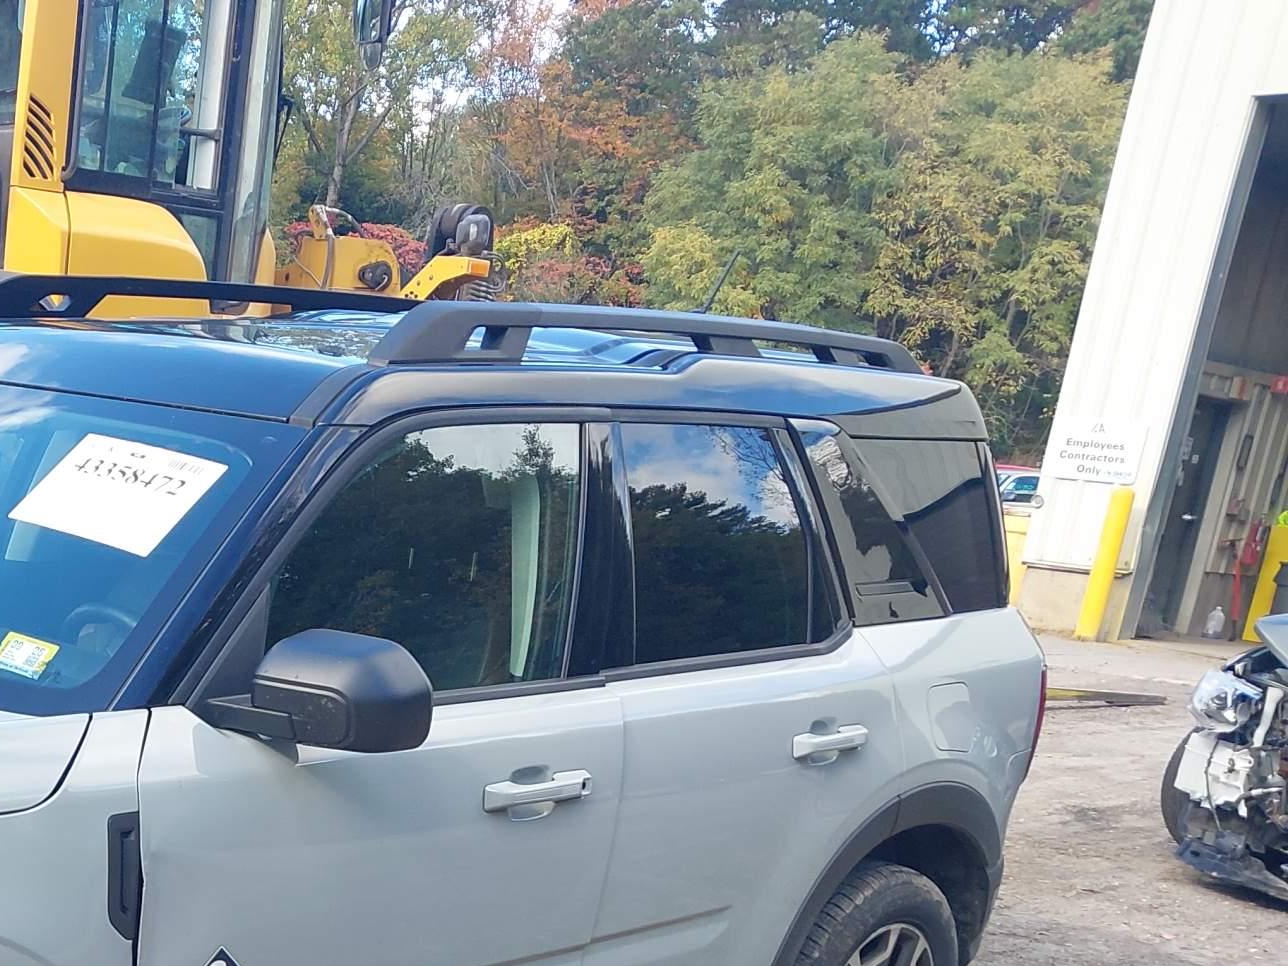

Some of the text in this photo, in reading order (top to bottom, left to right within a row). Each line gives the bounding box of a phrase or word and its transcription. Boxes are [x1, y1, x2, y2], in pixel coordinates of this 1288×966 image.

[1065, 437, 1125, 451] Employees
[1059, 450, 1125, 464] Contractors
[74, 457, 186, 496] 43358472
[1076, 464, 1101, 476] Only
